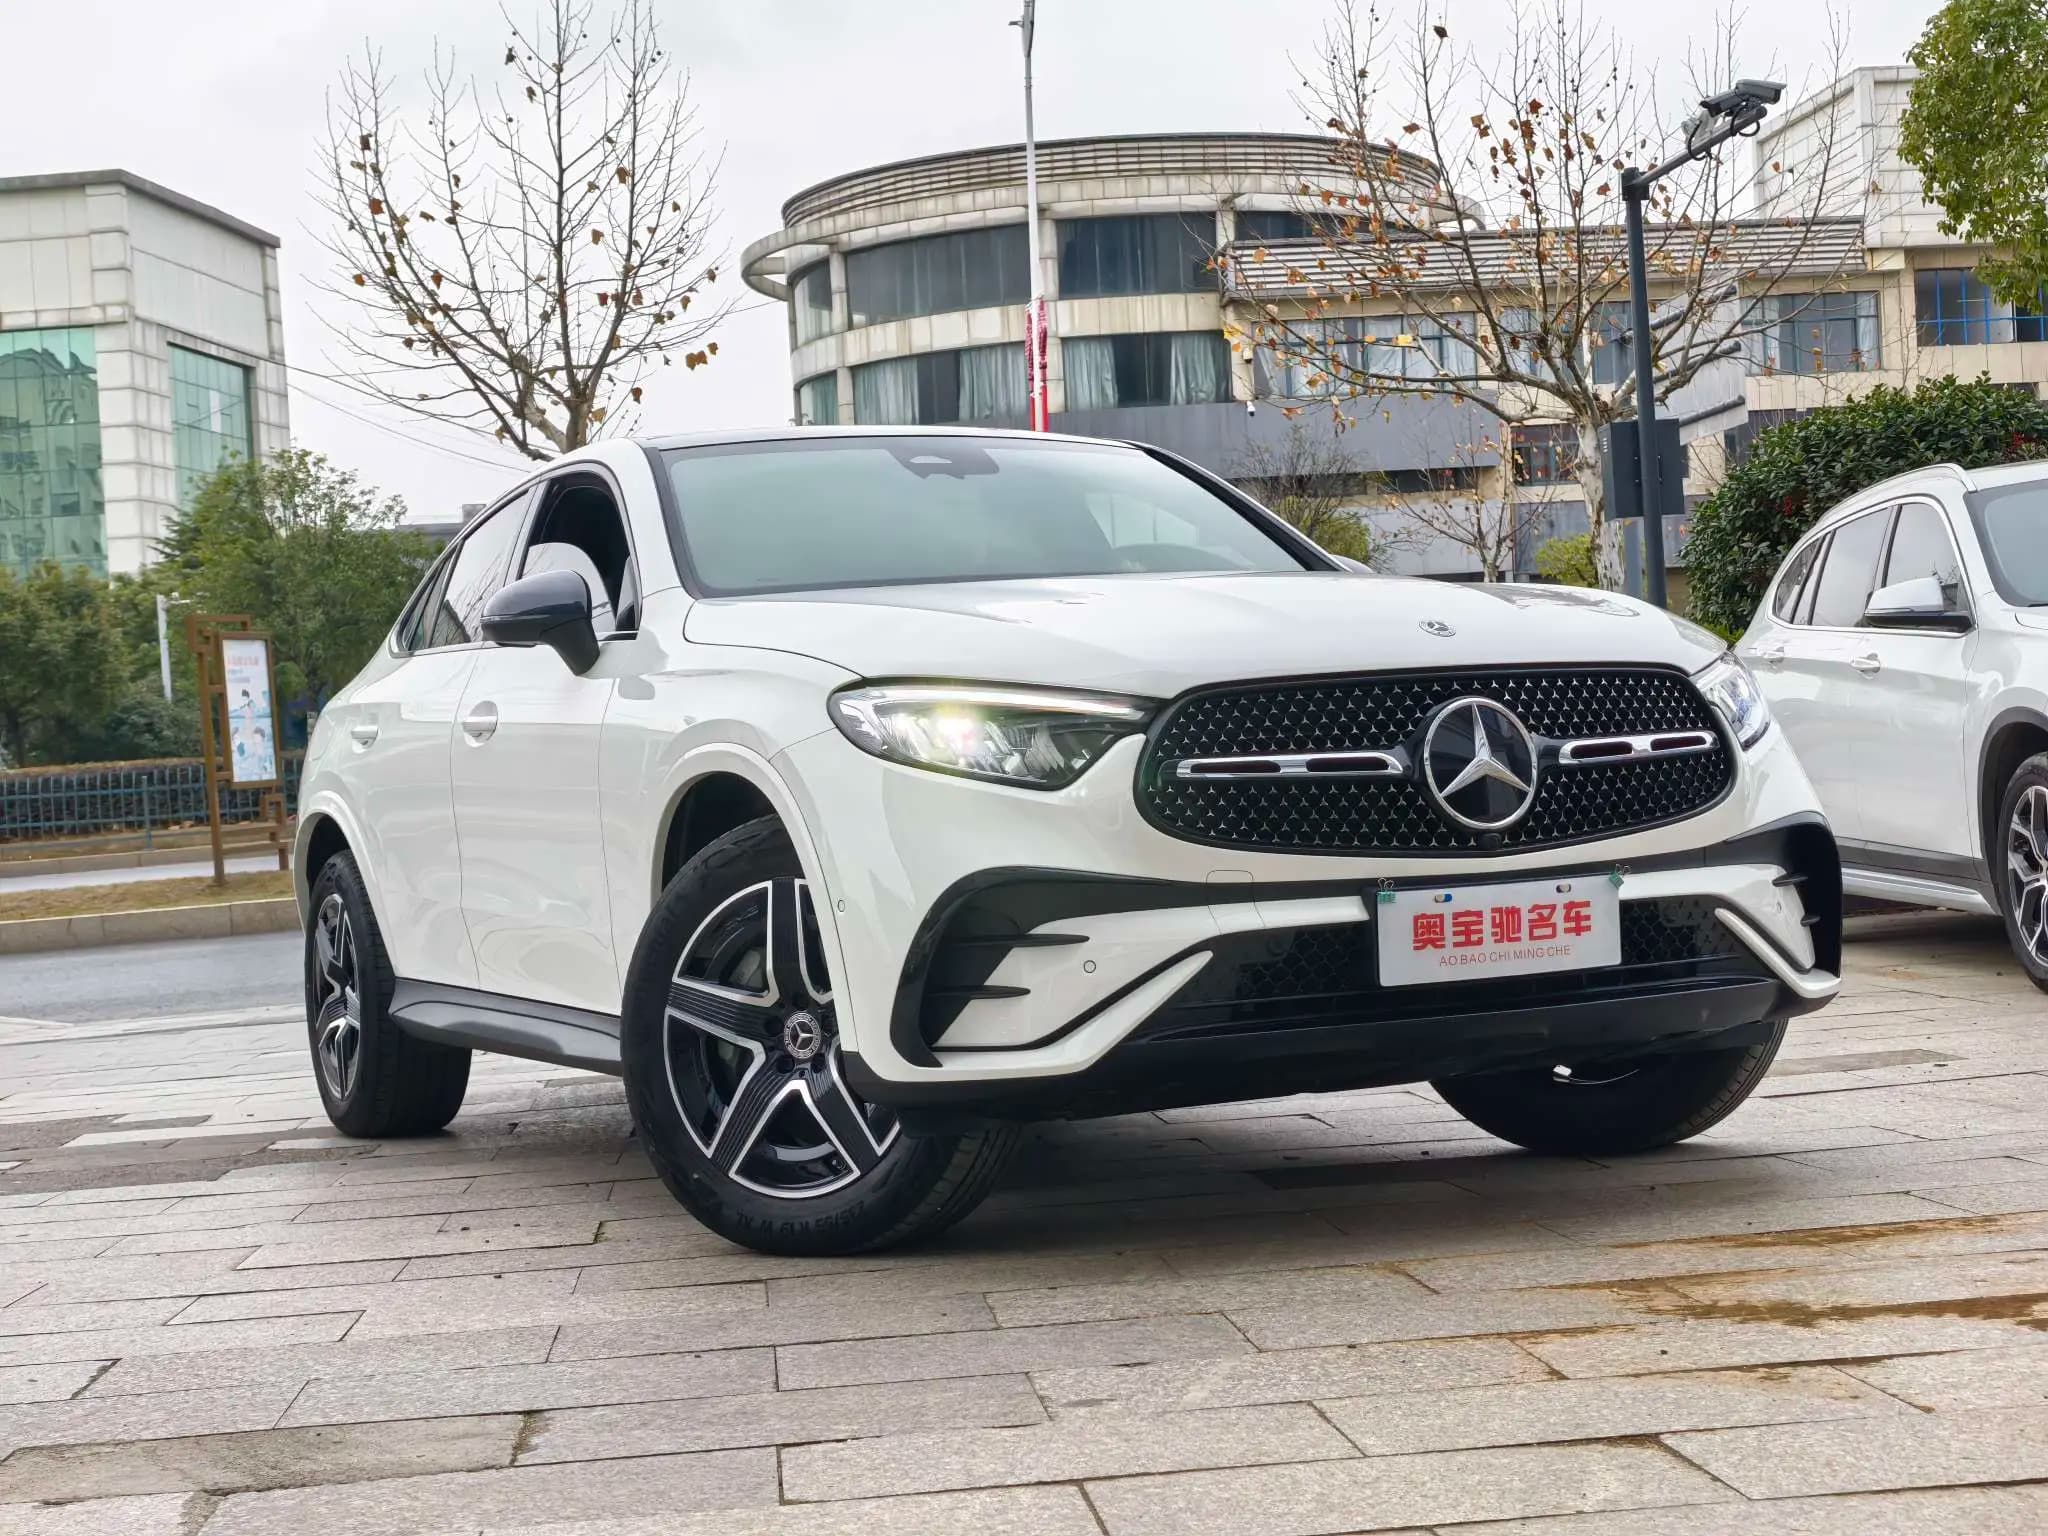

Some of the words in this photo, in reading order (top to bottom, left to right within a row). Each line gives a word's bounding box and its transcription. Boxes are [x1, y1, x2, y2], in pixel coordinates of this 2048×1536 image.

[1412, 900, 1592, 951] 奥宝驰名车
[1439, 955, 1458, 967] AO
[1460, 952, 1486, 965] BAO
[1489, 951, 1511, 962] CHI
[1513, 947, 1544, 960] MING
[1546, 945, 1571, 957] CHE
